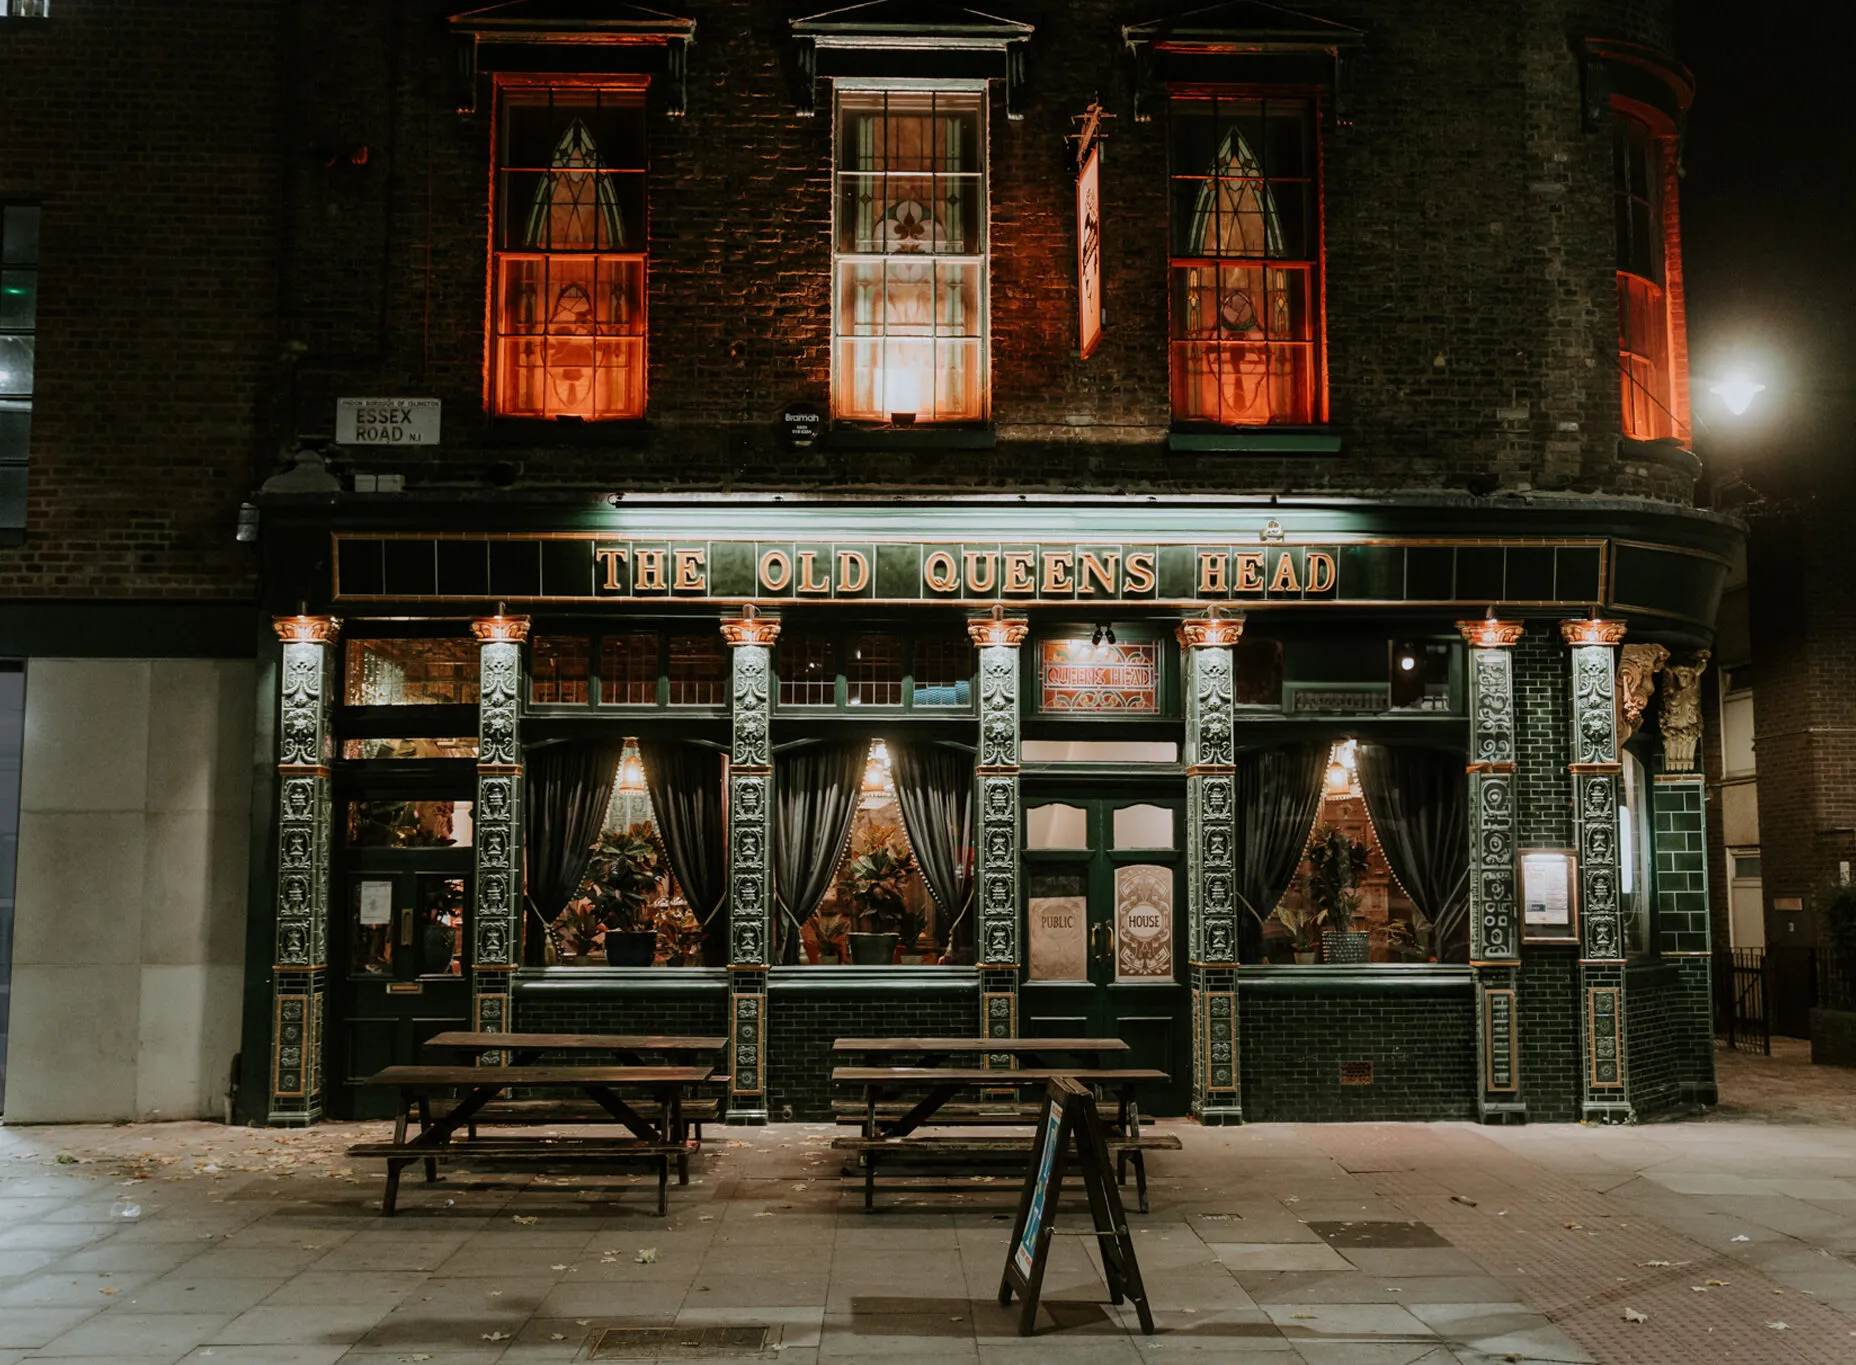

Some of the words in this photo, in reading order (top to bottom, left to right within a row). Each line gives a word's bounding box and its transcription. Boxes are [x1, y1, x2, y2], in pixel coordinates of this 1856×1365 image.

[356, 409, 412, 424] ESSEX
[785, 413, 819, 422] Bramah
[356, 426, 404, 441] ROAD
[596, 549, 706, 591] THE
[759, 551, 869, 593] OLD
[923, 551, 1157, 593] QUEENS
[1198, 551, 1337, 593] HEAD
[1047, 667, 1105, 685] QUEENS
[1110, 667, 1150, 686] HEAD
[1041, 915, 1074, 929] PUBLIC
[1128, 915, 1160, 928] HOUSE
